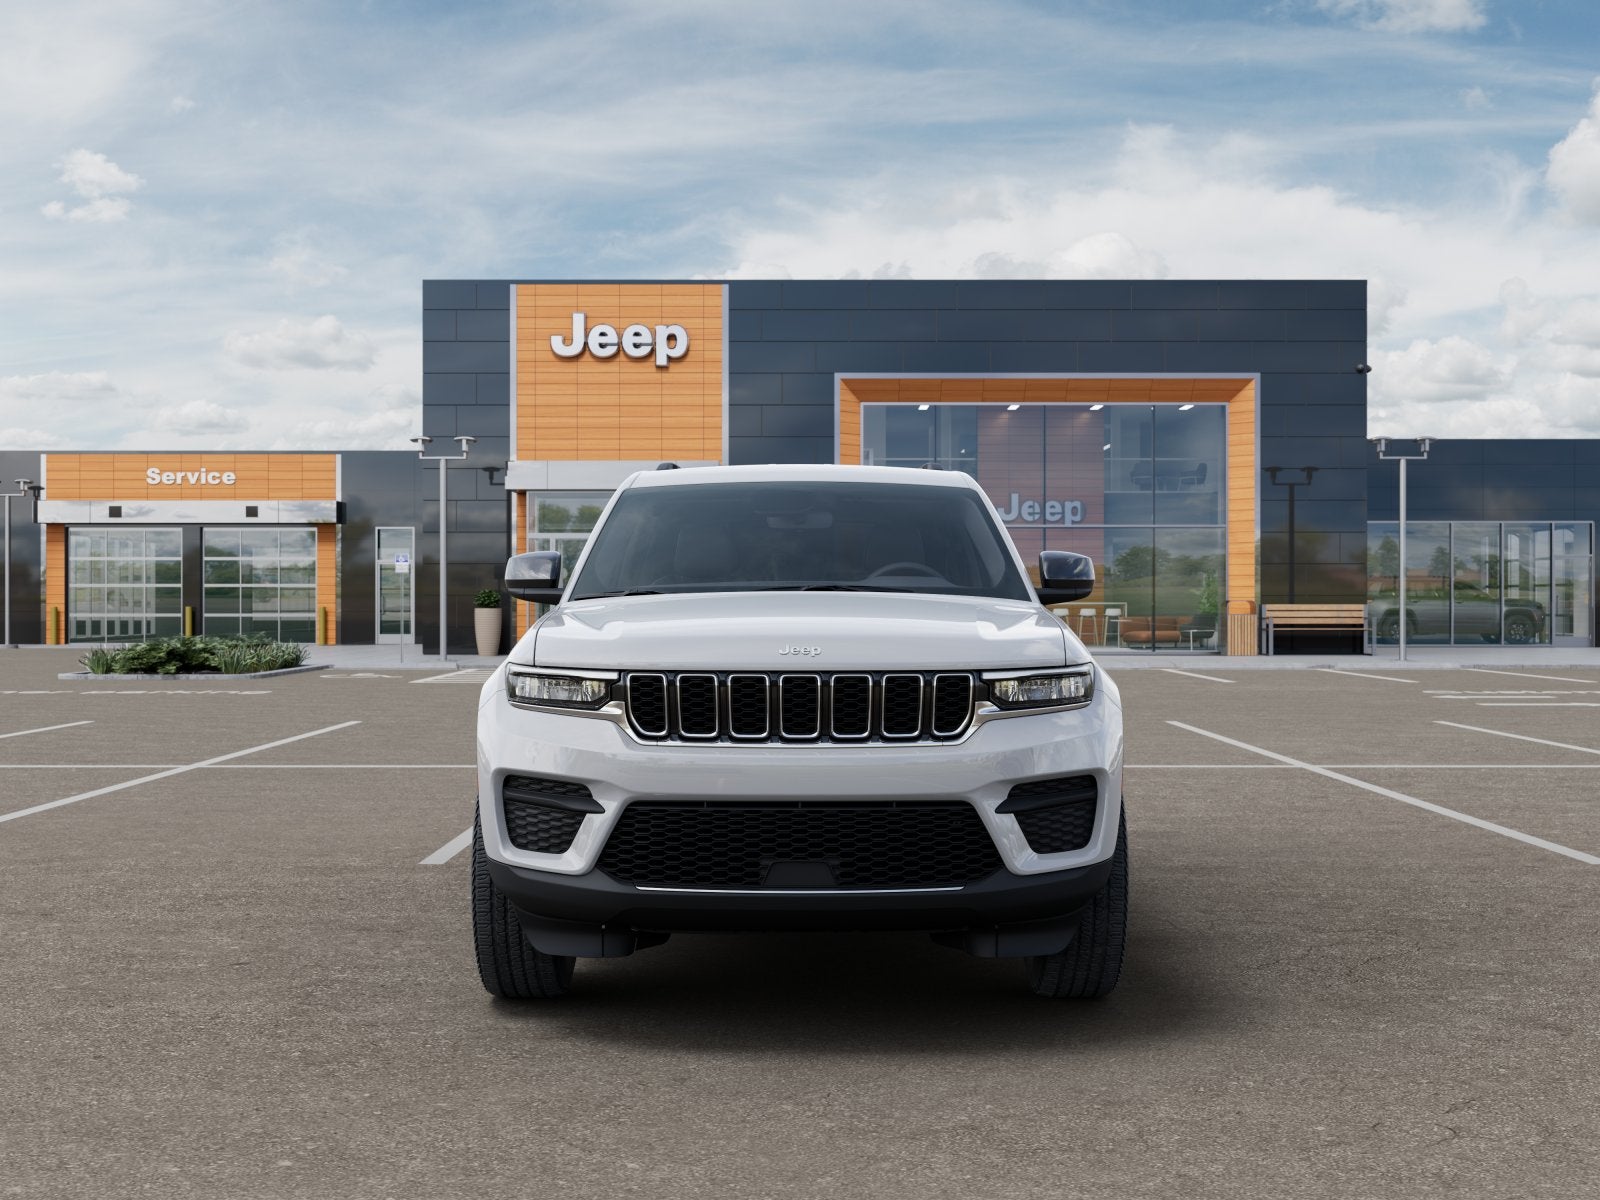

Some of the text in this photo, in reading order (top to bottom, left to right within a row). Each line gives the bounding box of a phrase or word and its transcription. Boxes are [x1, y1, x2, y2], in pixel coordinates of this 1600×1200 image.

[550, 311, 690, 368] Jeep
[145, 467, 237, 485] Service
[997, 492, 1085, 526] Jeep
[778, 642, 822, 657] Jeep
